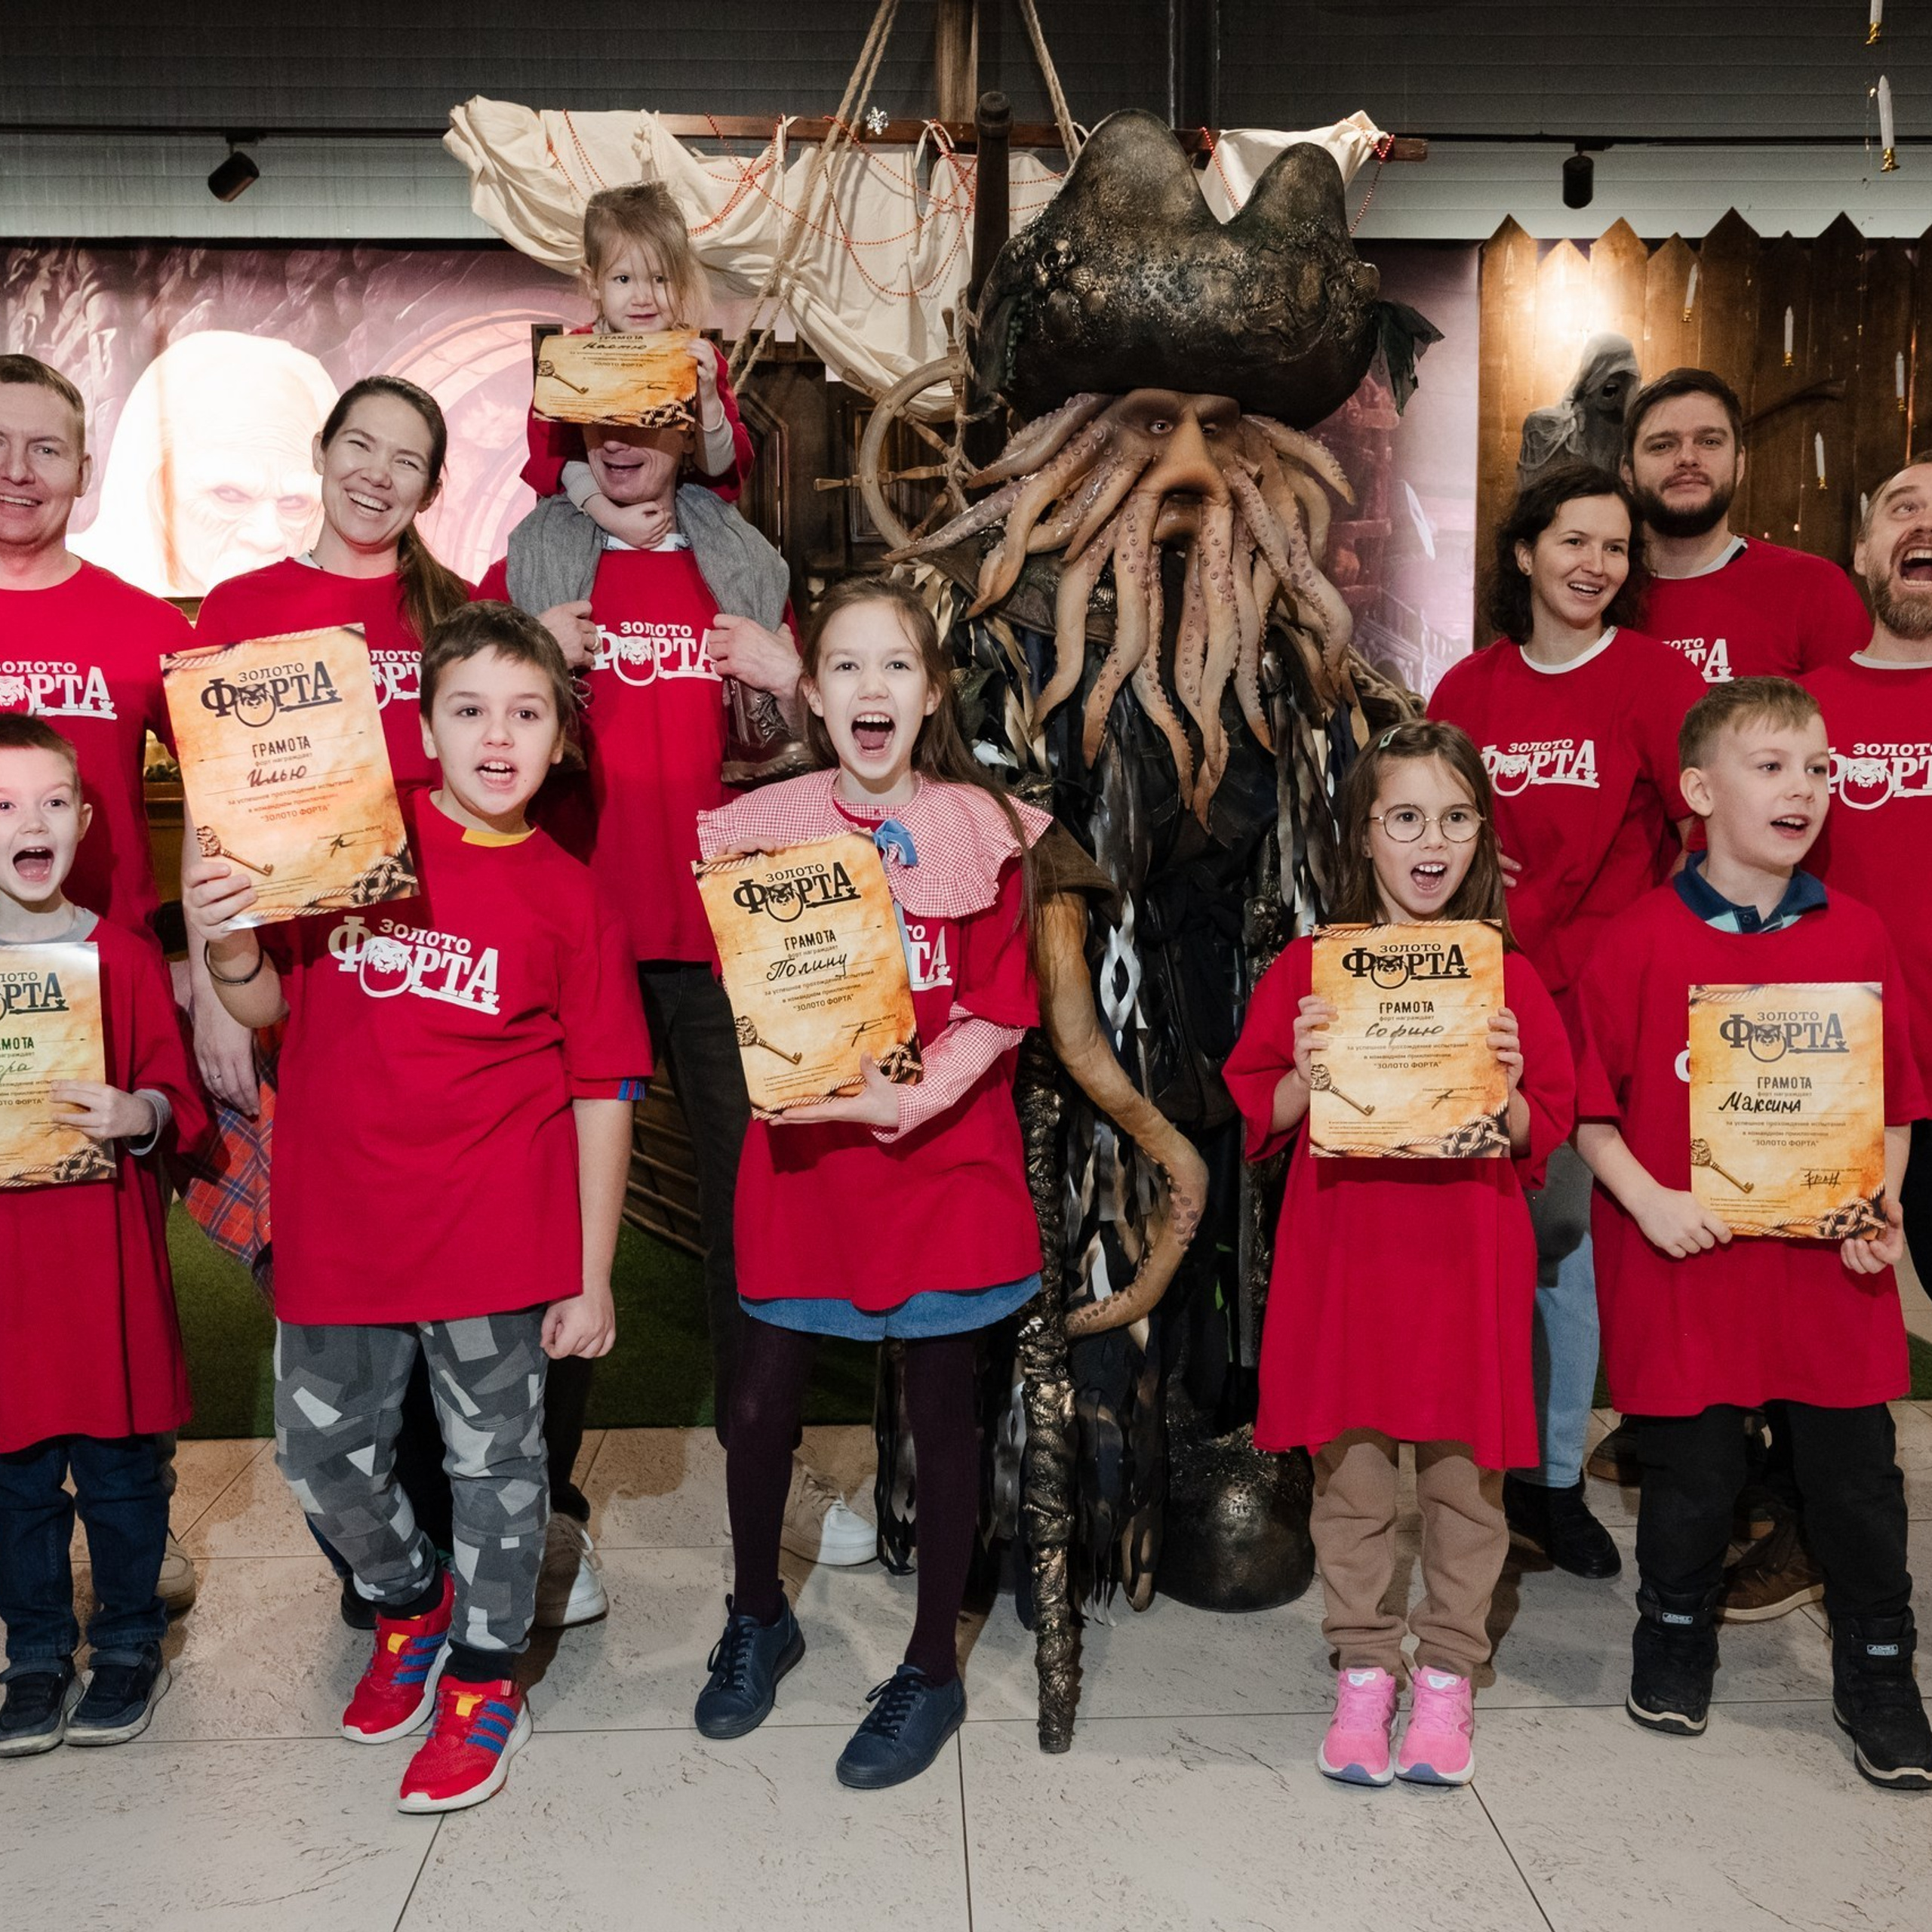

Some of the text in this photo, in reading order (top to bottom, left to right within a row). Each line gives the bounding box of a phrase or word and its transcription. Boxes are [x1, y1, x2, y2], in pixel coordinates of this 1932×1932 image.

[620, 621, 693, 638] ЗОЛОТО
[370, 650, 423, 662] ЛОТО
[0, 660, 78, 674] ОЛОТО
[238, 663, 305, 682] ЗОЛОТО
[201, 660, 343, 728] ФОРТА
[251, 735, 311, 758] ГРАМОТА
[1509, 739, 1574, 753] ЗОЛОТО
[1853, 743, 1932, 756] ЗОЛОТ
[247, 765, 307, 788] Илью
[765, 863, 825, 883] ЗОЛОТО
[733, 862, 861, 922] ФОРТА
[379, 918, 472, 955] ЗОЛОТО
[784, 930, 836, 951] ГРАМОТА
[803, 944, 838, 955] награждает
[1380, 943, 1441, 953] ЗОЛОТО
[328, 915, 500, 1015] ФОРТА
[766, 953, 848, 981] Полину
[1342, 944, 1472, 989] ФОРТА
[793, 993, 854, 1012] "ЗОЛОТО ФОРТА"
[1379, 1001, 1434, 1014] ГРАМОТА
[1757, 1011, 1819, 1021] ЗОЛОТО
[1365, 1023, 1444, 1048] Софию
[1719, 1013, 1850, 1063] ФОРТА
[1758, 1076, 1812, 1089] ГРАМОТА
